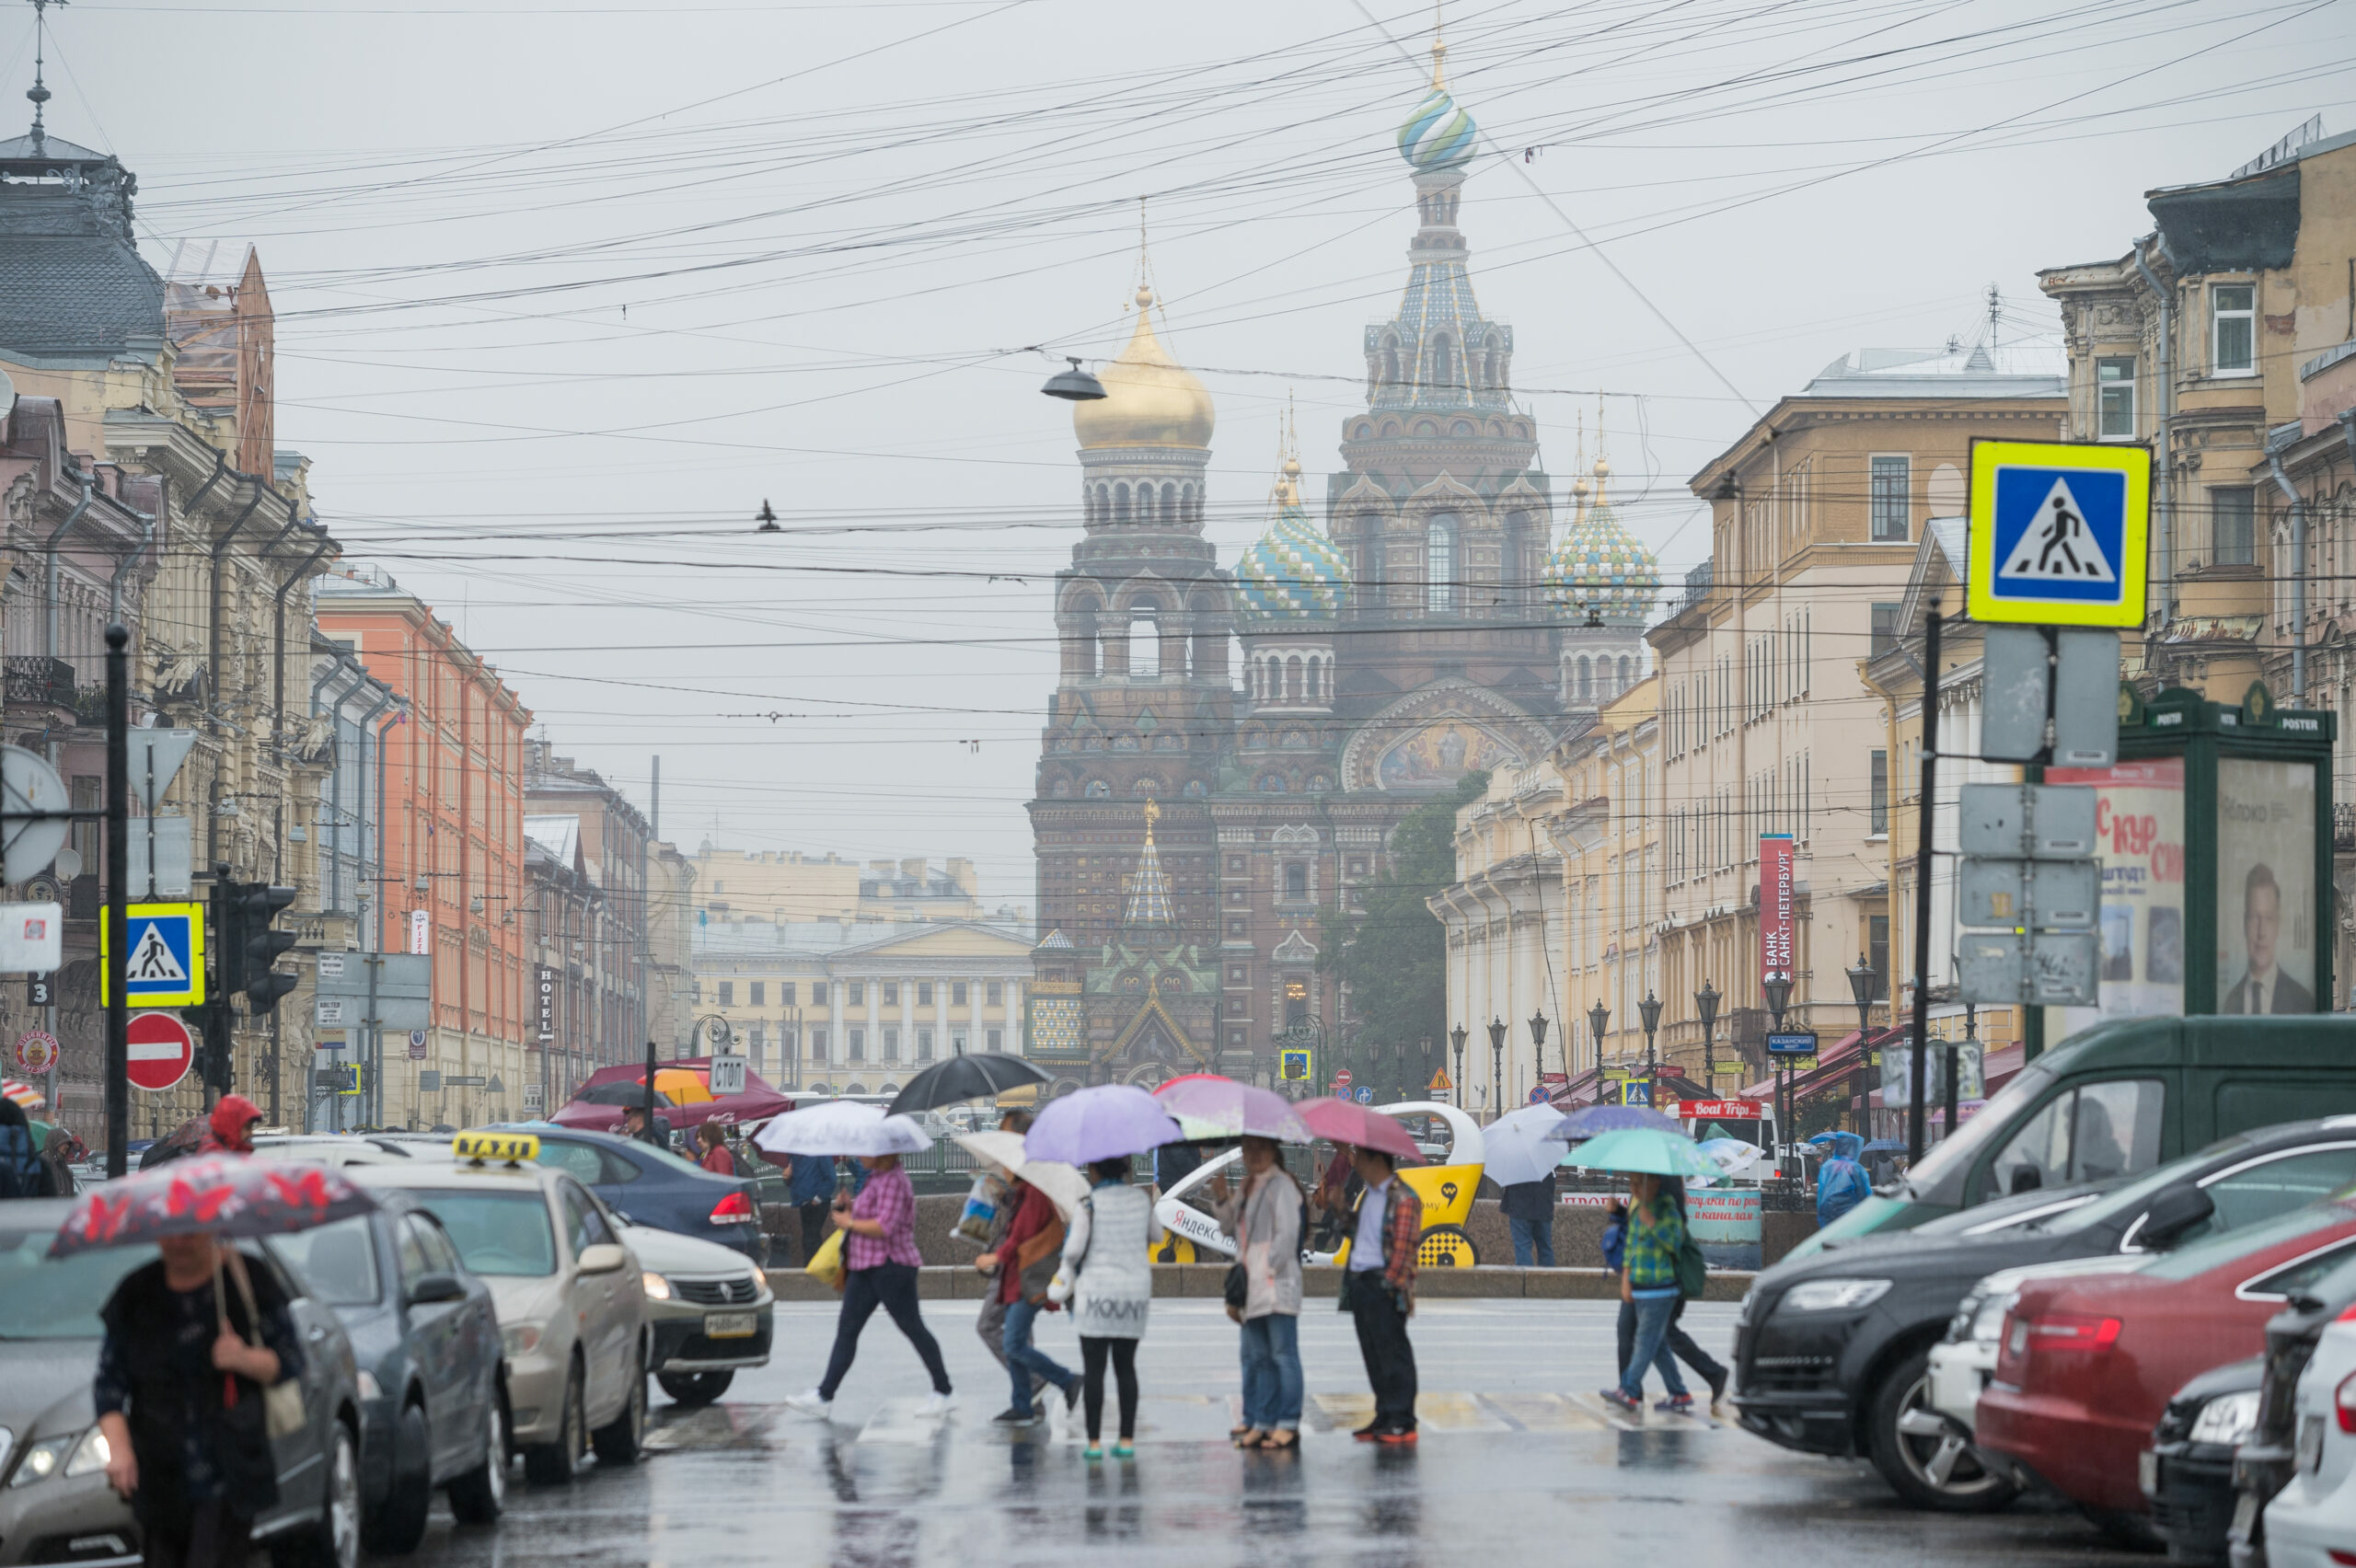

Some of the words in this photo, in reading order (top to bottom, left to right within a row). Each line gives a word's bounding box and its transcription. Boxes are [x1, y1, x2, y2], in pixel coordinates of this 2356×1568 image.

[2282, 718, 2318, 732] POSTER
[1778, 850, 1790, 965] САНКТ-ПЕТЕРБУРГ
[1766, 931, 1777, 965] БАНК
[541, 971, 552, 1032] HOTEL
[715, 1062, 742, 1088] СТОП
[1694, 1101, 1721, 1115] Boat
[1724, 1101, 1750, 1119] Trips
[461, 1137, 526, 1157] TAXI
[1728, 1197, 1742, 1206] по
[1172, 1209, 1221, 1242] Яндекс
